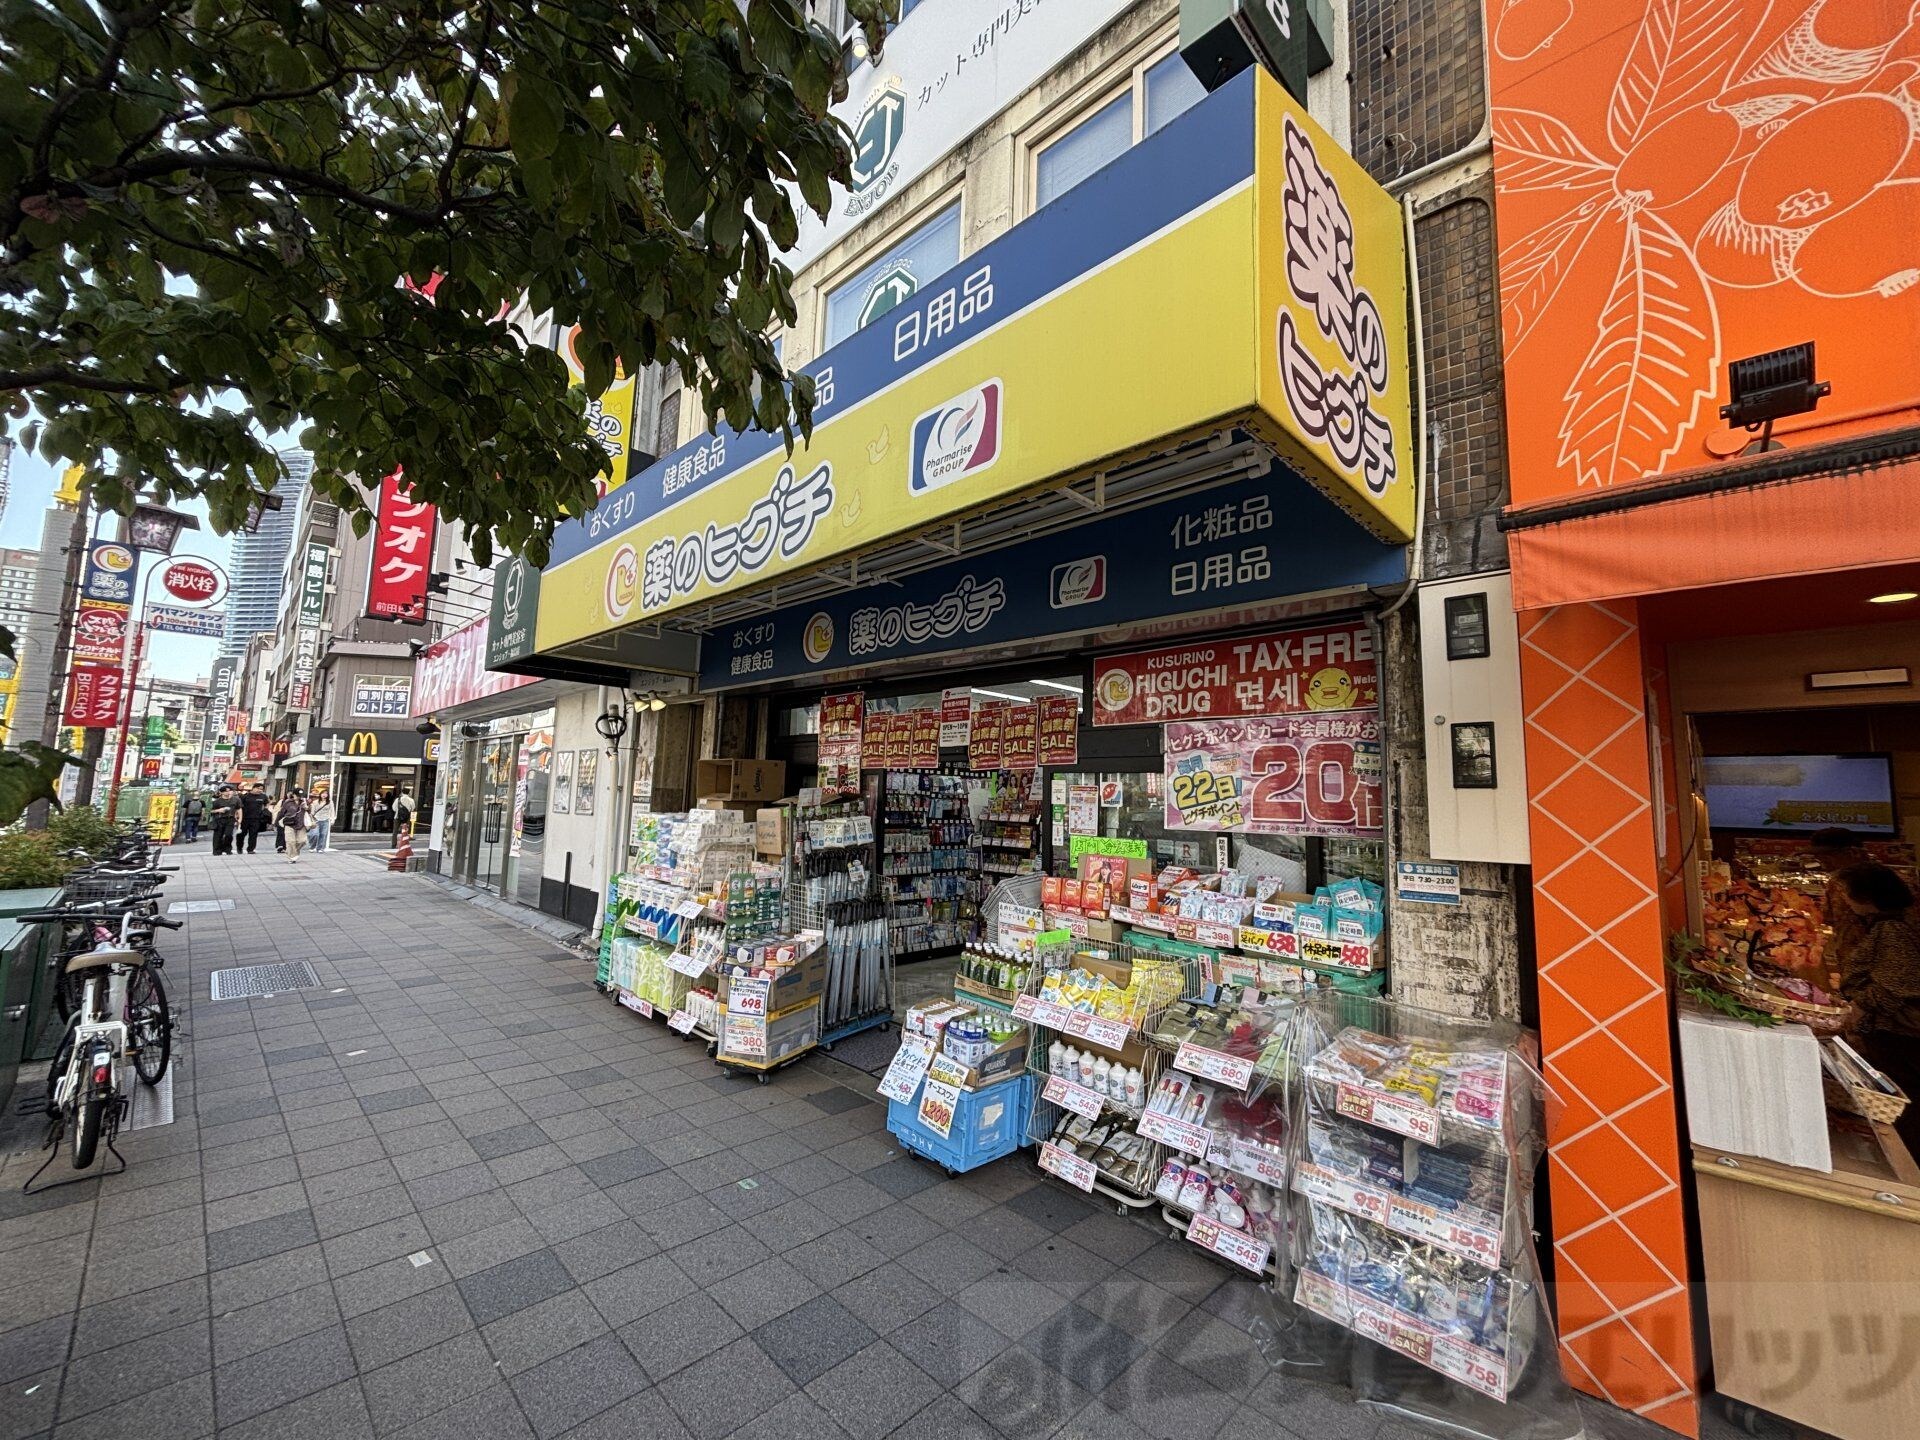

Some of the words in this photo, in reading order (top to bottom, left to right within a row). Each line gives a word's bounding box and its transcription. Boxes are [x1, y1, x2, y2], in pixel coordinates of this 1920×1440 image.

[1282, 111, 1389, 396] 薬の
[893, 264, 993, 363] 日用品
[1278, 303, 1397, 500] ヒグチ
[661, 434, 726, 499] 健康食品
[925, 443, 973, 472] Pharmarise
[932, 458, 966, 478] GROUP
[589, 491, 635, 539] おくすり
[1170, 494, 1273, 550] 化粧品
[640, 458, 835, 610] 薬のヒグチ
[303, 548, 327, 610] 福島ビル
[1171, 545, 1272, 596] 日用品
[167, 570, 215, 594] 消火栓
[150, 605, 224, 622] アパマンショップ
[849, 573, 1007, 656] 薬のヒグチ
[732, 622, 775, 649] おくすり
[730, 649, 774, 676] 健康食品
[1147, 649, 1216, 671] KUSURINO
[1136, 664, 1228, 698] HIGUCHI
[93, 673, 120, 721] カラオケ
[358, 690, 408, 702] 個別教室
[1235, 672, 1300, 711] 면세
[356, 702, 406, 713] のトライ
[1146, 690, 1211, 718] DRUG
[823, 719, 858, 737] SALE
[862, 744, 885, 757] SALE
[886, 743, 911, 756] SALE
[912, 742, 937, 755] SALE
[970, 742, 1000, 757] SALE
[1003, 740, 1036, 755] SALE
[1040, 734, 1075, 750] SALE
[1181, 800, 1243, 826] ヒグチポイント
[1177, 859, 1197, 867] POINT
[1071, 923, 1087, 935] 1280
[1212, 932, 1229, 942] 398
[1302, 943, 1342, 959] 休足時間
[741, 998, 762, 1009] 698
[1045, 1013, 1062, 1024] 648
[743, 1036, 762, 1048] 980
[1102, 1031, 1120, 1042] 900
[1221, 1067, 1243, 1080] 680
[927, 1081, 956, 1101] オーエスワン
[1079, 1099, 1095, 1112] 548
[1341, 1102, 1369, 1118] SALE
[1409, 1117, 1429, 1134] 98
[1180, 1134, 1201, 1149] 1180
[1073, 1169, 1089, 1183] 648
[1256, 1163, 1283, 1178] 880
[1392, 1206, 1433, 1226] アルミホイル
[1192, 1229, 1213, 1246] SALE
[1449, 1226, 1492, 1253] 158
[1235, 1245, 1258, 1263] 548
[1395, 1336, 1426, 1359] SALE
[1463, 1360, 1498, 1387] 758
